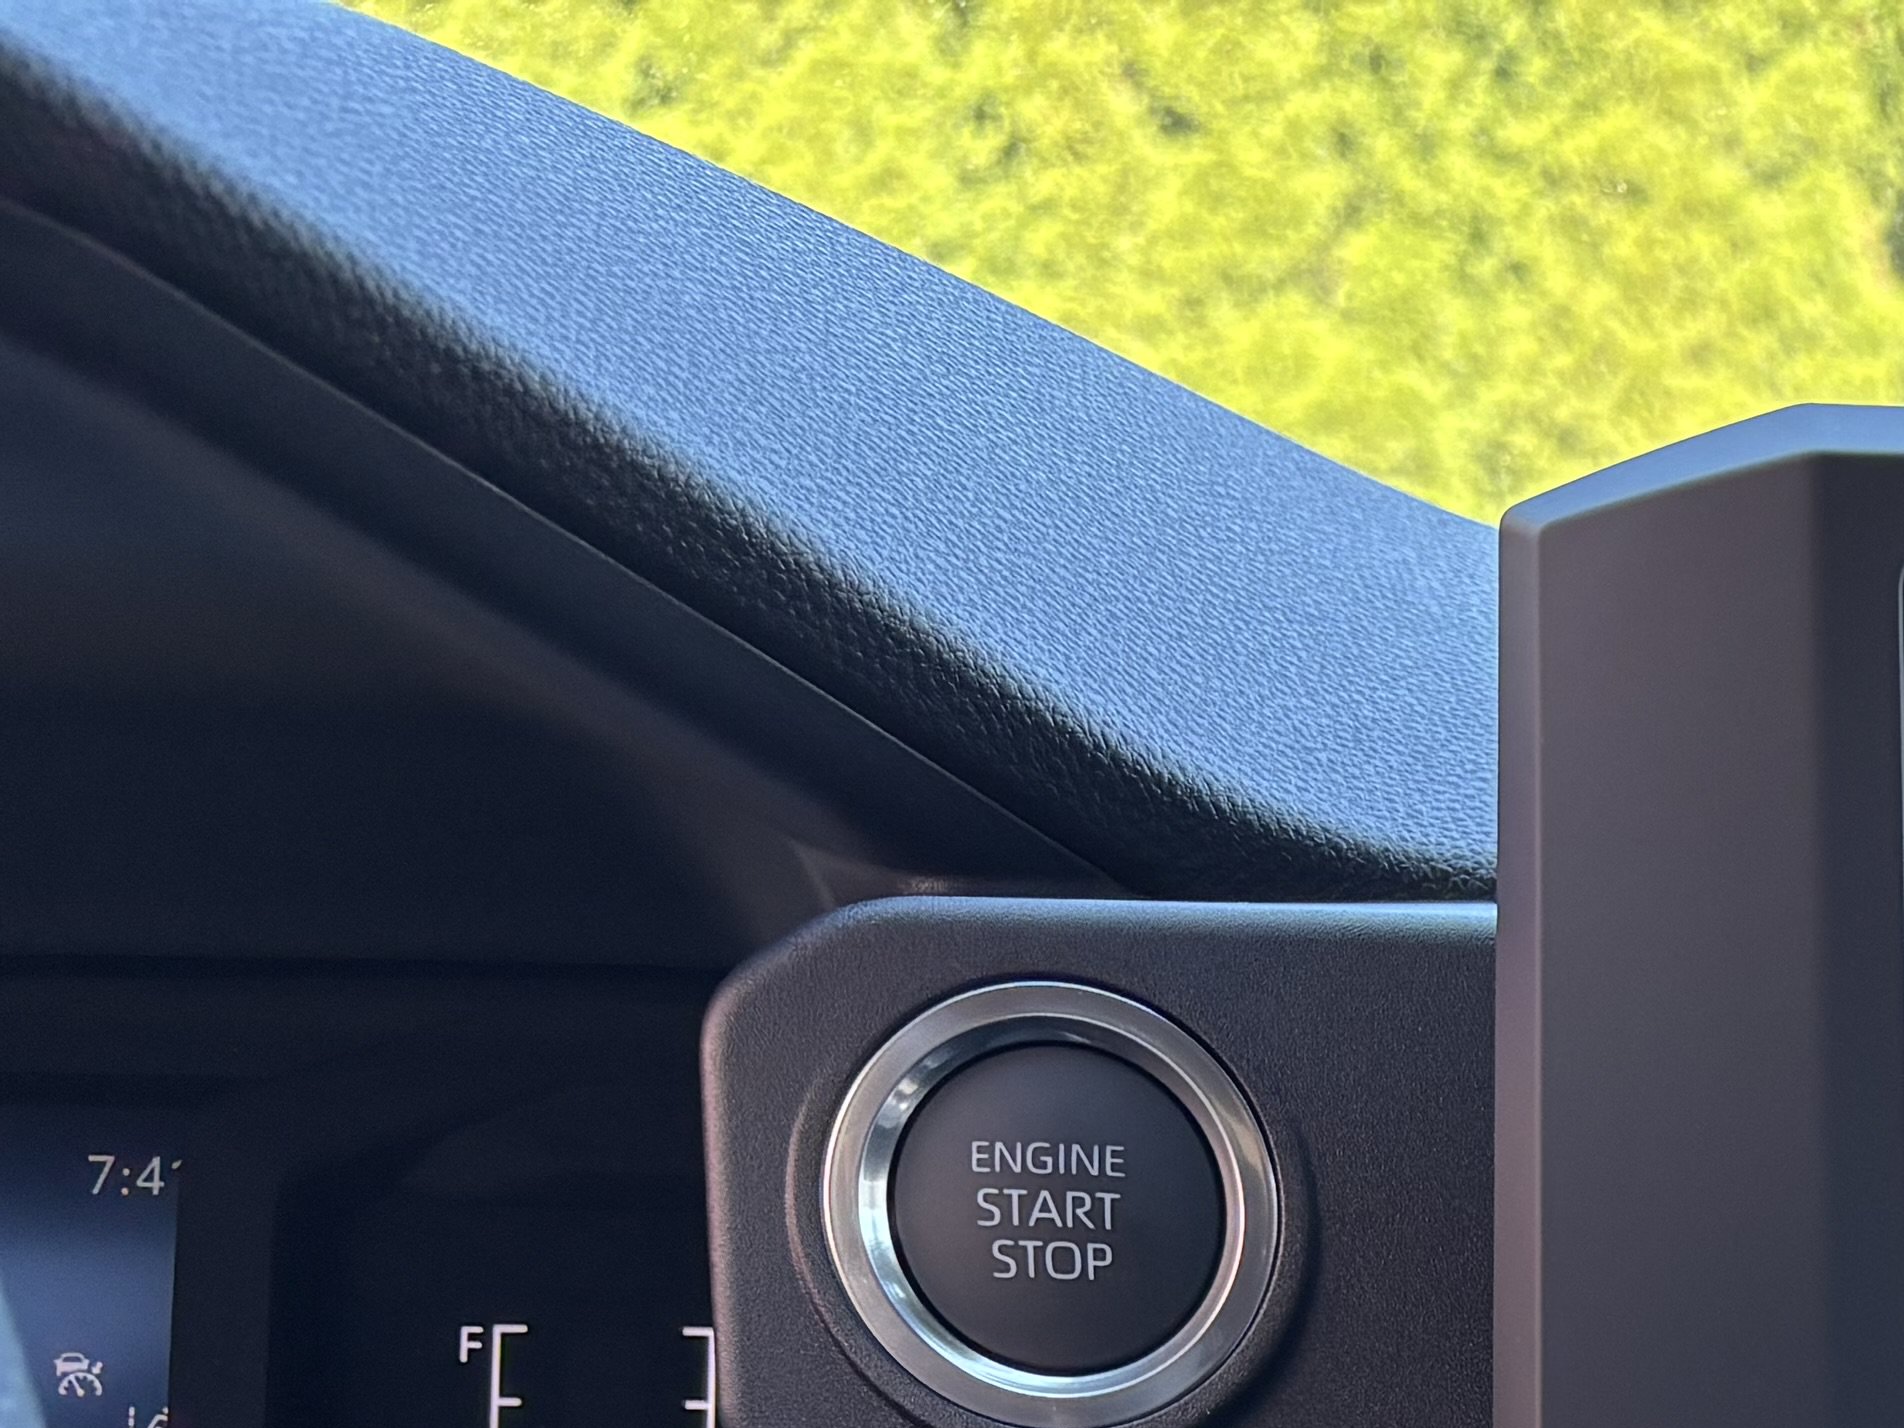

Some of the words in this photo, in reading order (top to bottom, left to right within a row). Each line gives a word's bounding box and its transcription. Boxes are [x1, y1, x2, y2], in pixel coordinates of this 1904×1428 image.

[88, 1155, 182, 1196] 7:4
[971, 1141, 1126, 1177] ENGINE
[976, 1188, 1121, 1230] START
[992, 1239, 1113, 1281] STOP
[459, 1325, 485, 1363] F
